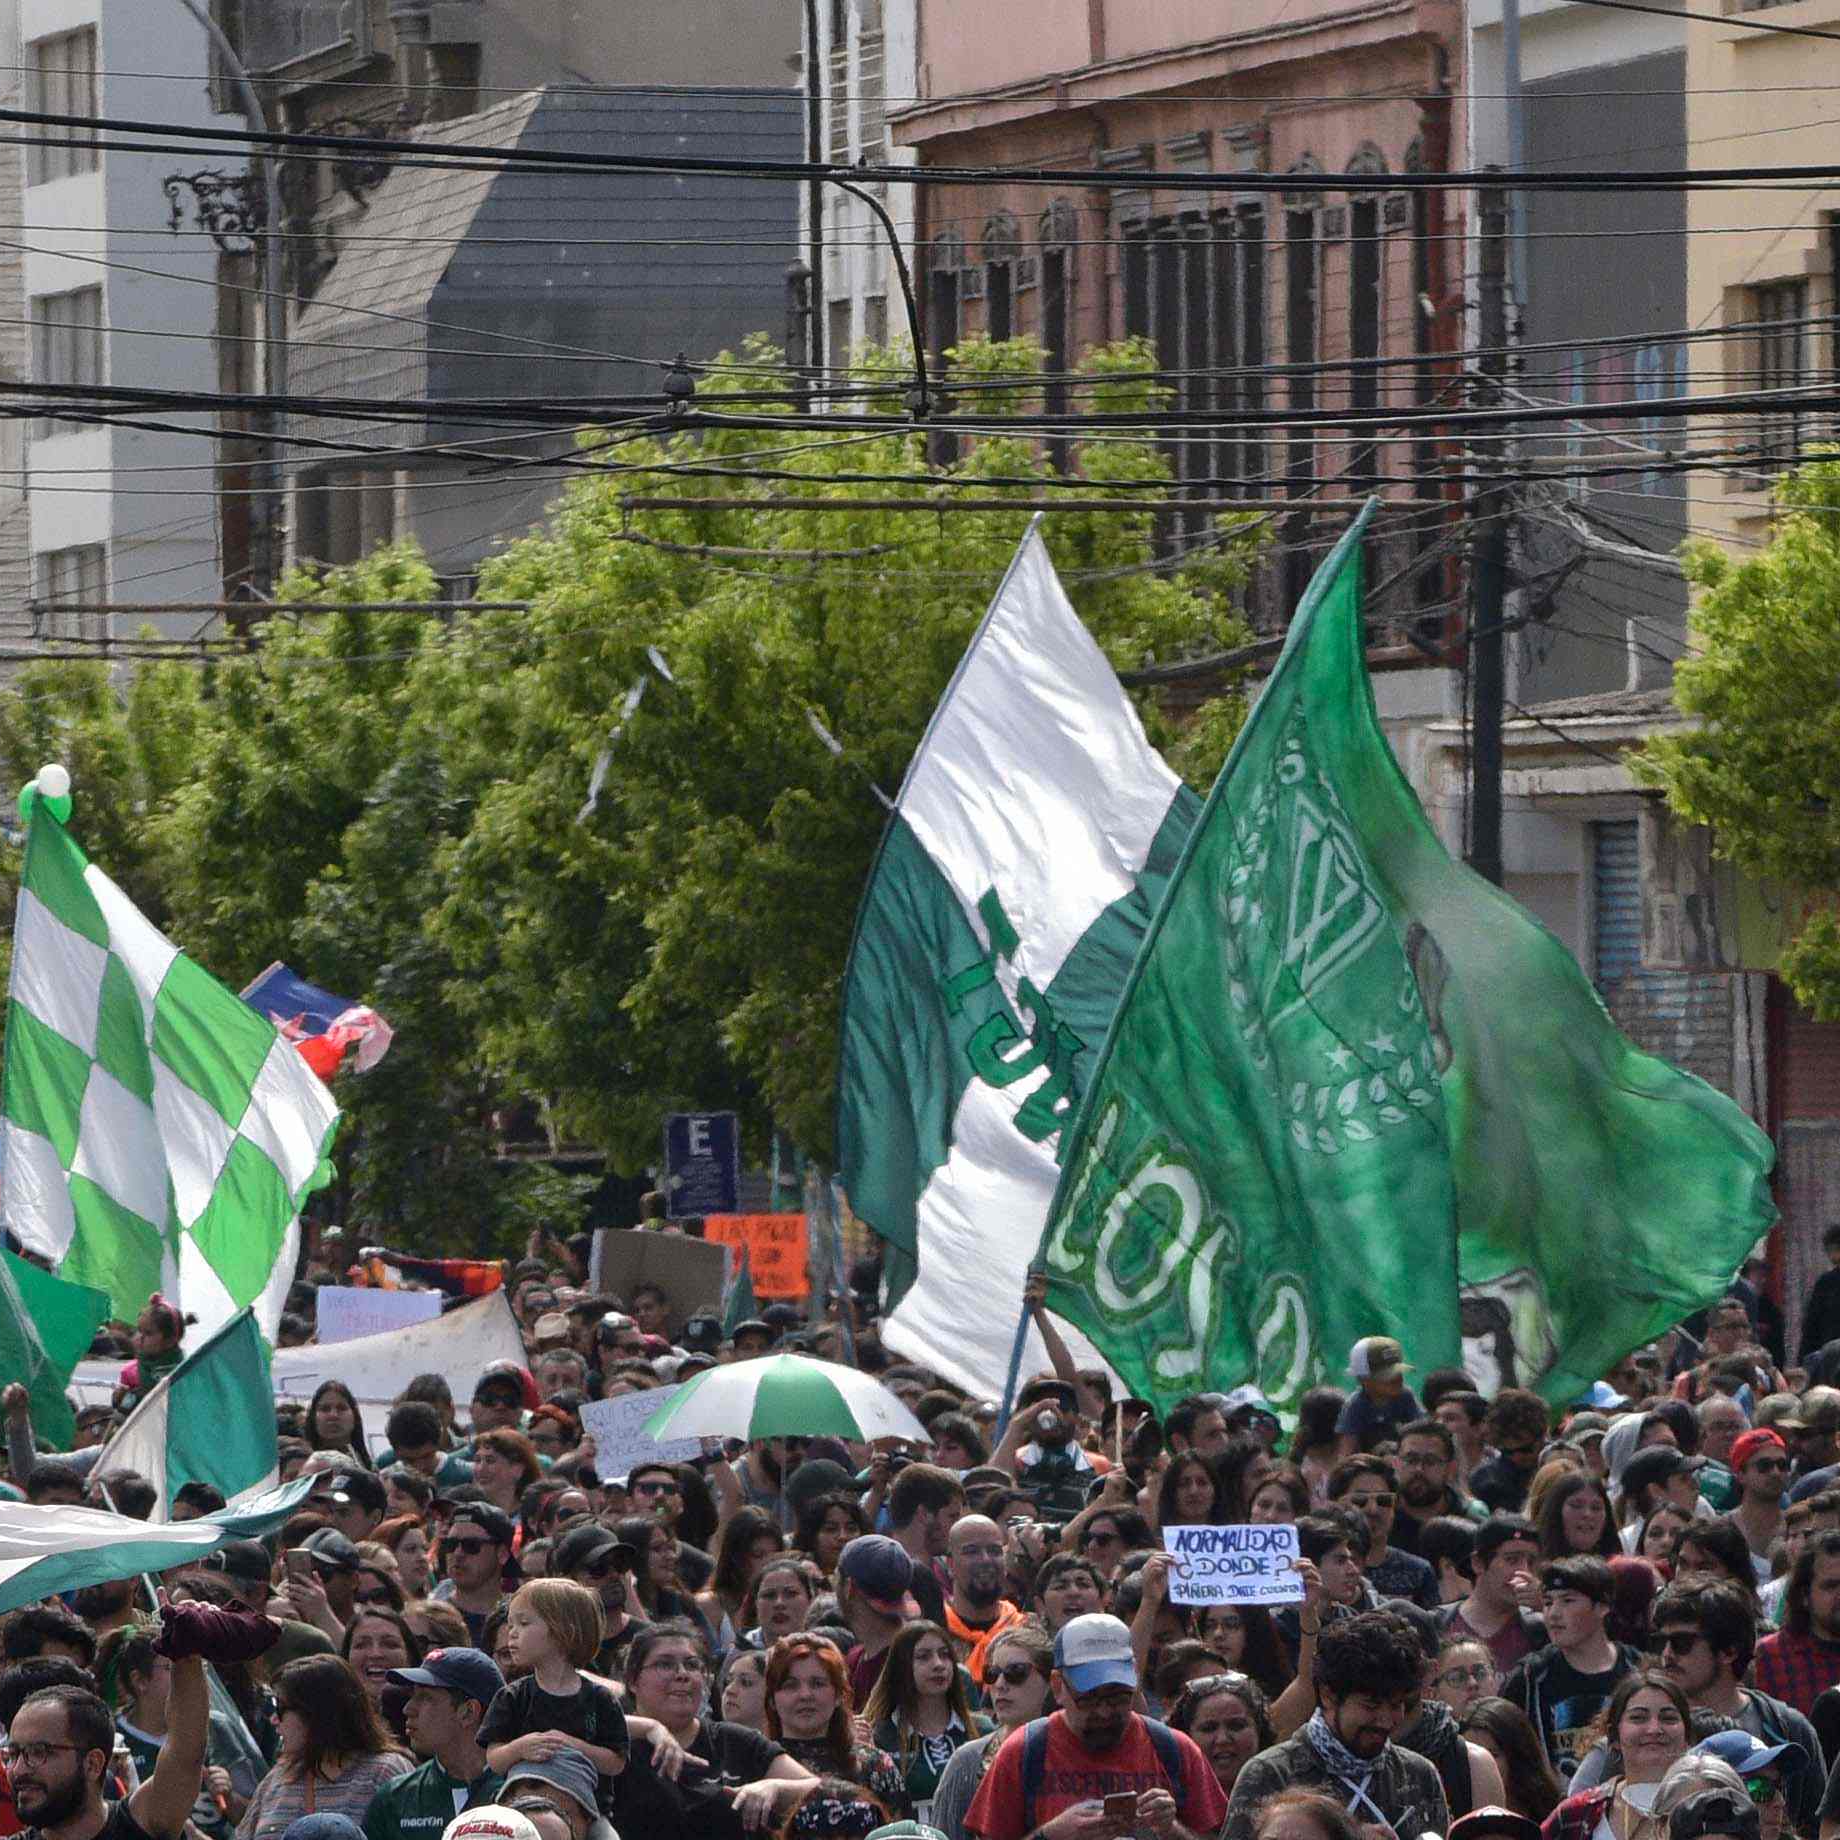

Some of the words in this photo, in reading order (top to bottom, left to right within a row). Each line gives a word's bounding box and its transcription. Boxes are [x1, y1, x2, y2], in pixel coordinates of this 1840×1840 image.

[688, 1118, 712, 1156] E
[1175, 1529, 1291, 1554] NORMALIDAD
[400, 1815, 444, 1832] macron
